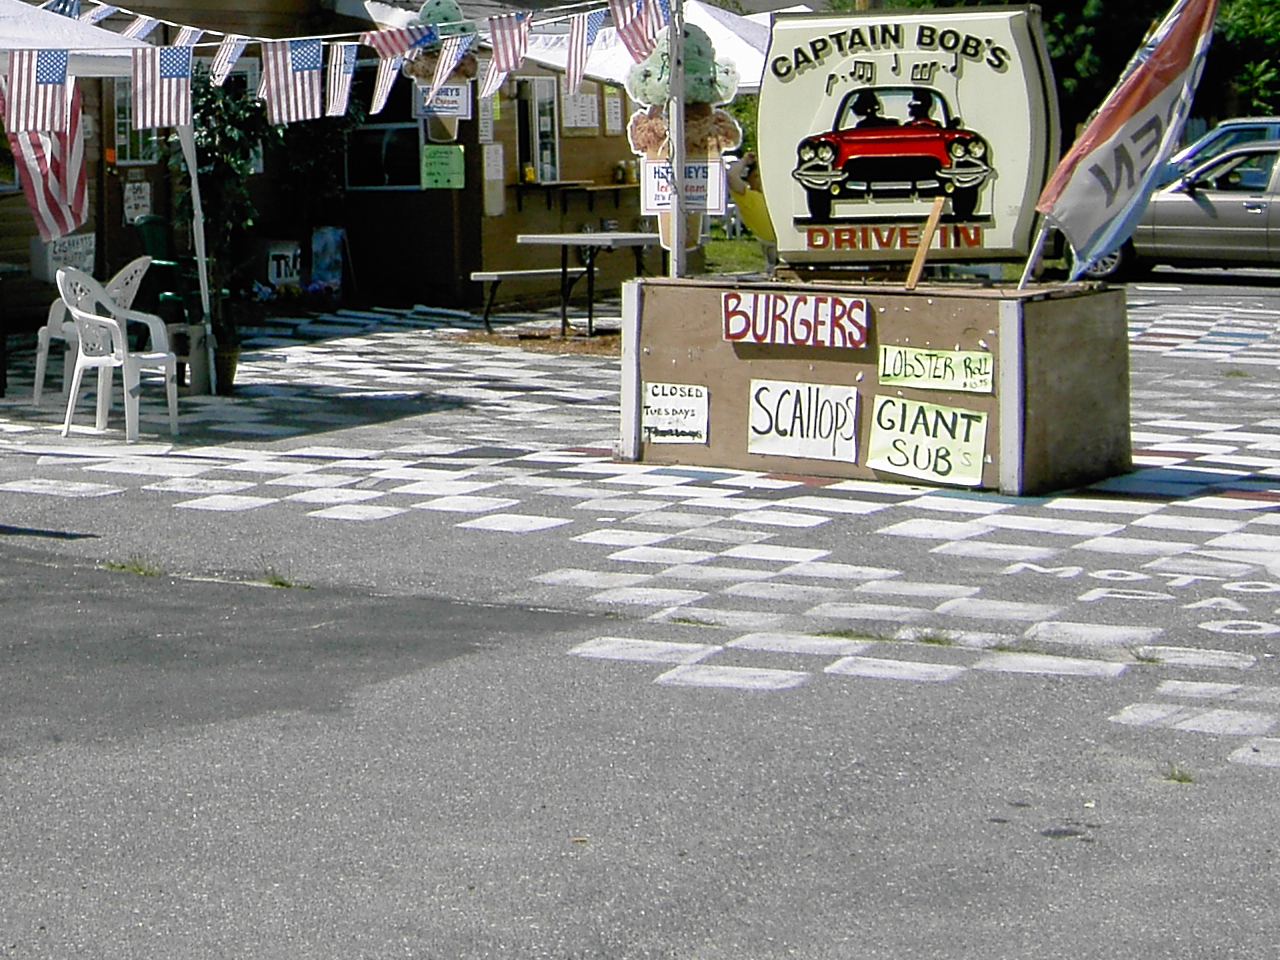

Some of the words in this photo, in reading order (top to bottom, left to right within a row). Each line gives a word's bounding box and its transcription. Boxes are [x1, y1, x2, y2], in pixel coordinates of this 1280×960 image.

[770, 23, 903, 81] CAPTAIN
[916, 24, 1011, 71] BOB'S
[805, 225, 921, 250] DRIVE
[938, 224, 982, 249] IN
[723, 292, 868, 348] BURGERS
[651, 384, 703, 398] CLOSED
[876, 399, 983, 443] GIANT
